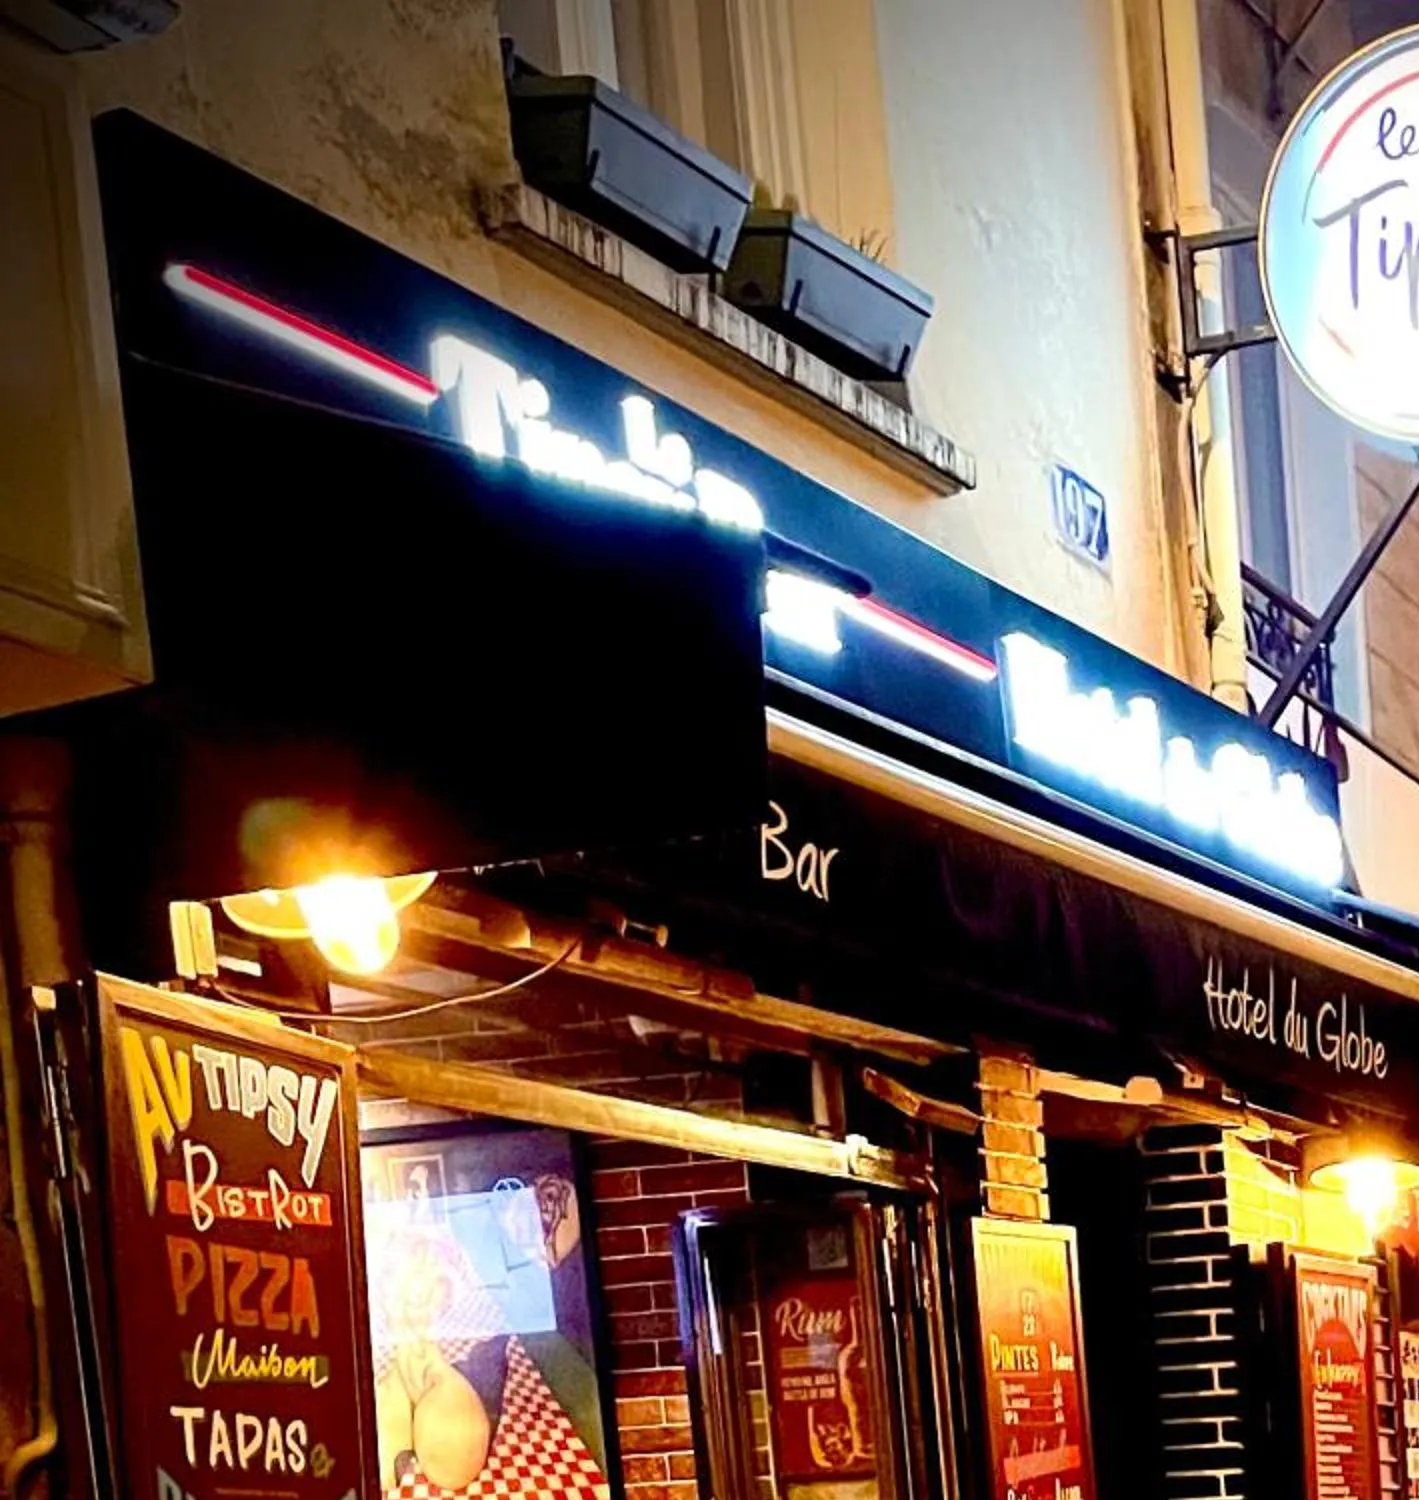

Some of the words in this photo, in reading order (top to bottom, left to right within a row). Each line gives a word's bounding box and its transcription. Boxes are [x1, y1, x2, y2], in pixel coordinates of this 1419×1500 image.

[1052, 466, 1103, 556] 197
[759, 801, 840, 902] Bar
[1202, 954, 1278, 1046] Hotel
[1283, 975, 1311, 1060] du
[1315, 992, 1389, 1080] Globe
[166, 1235, 320, 1340] PIZZA
[775, 1297, 846, 1342] Rum
[192, 1328, 329, 1389] Maison
[169, 1405, 308, 1473] TAPAS
